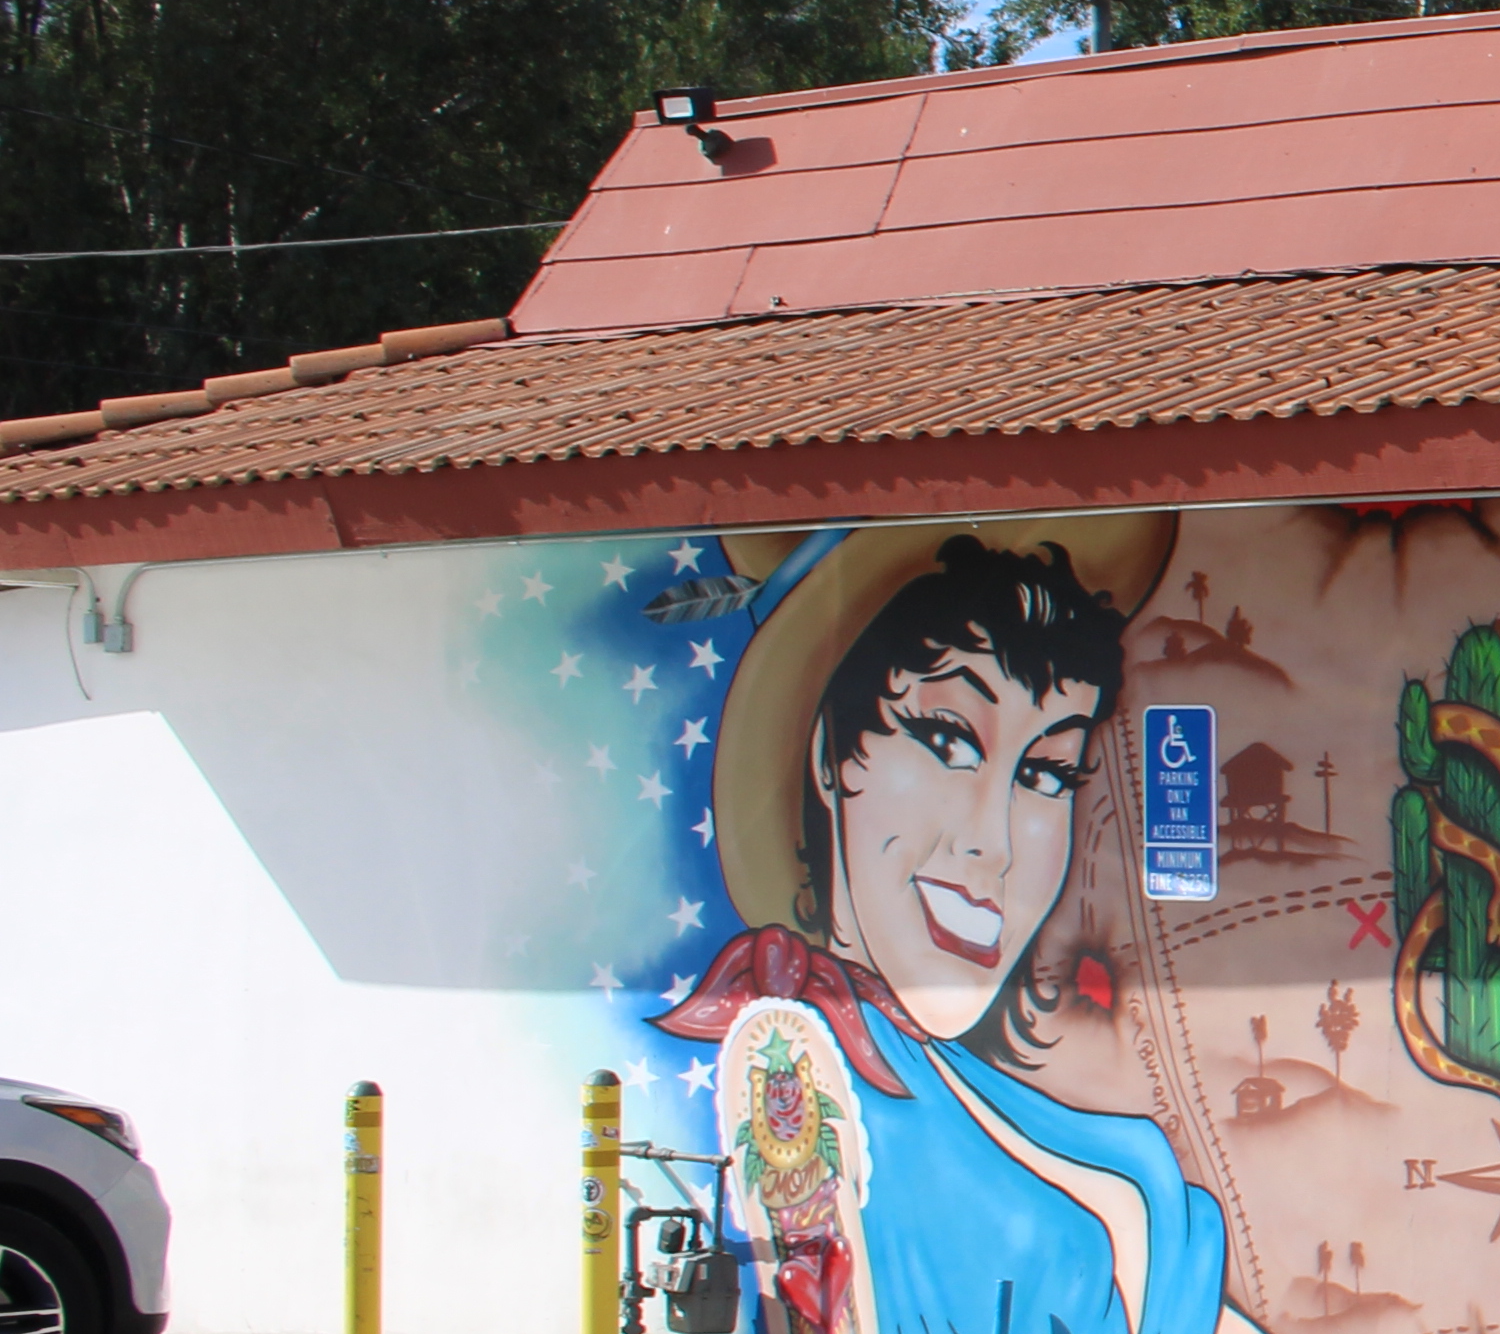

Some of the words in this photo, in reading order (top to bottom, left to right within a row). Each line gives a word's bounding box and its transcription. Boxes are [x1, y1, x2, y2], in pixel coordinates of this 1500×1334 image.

[1159, 771, 1199, 785] PARKING
[1167, 789, 1192, 803] ONLY
[1169, 807, 1189, 822] VAN
[1152, 824, 1208, 840] ACCESSIBLE
[1157, 851, 1203, 868] MINIMUM
[1404, 1159, 1438, 1190] N
